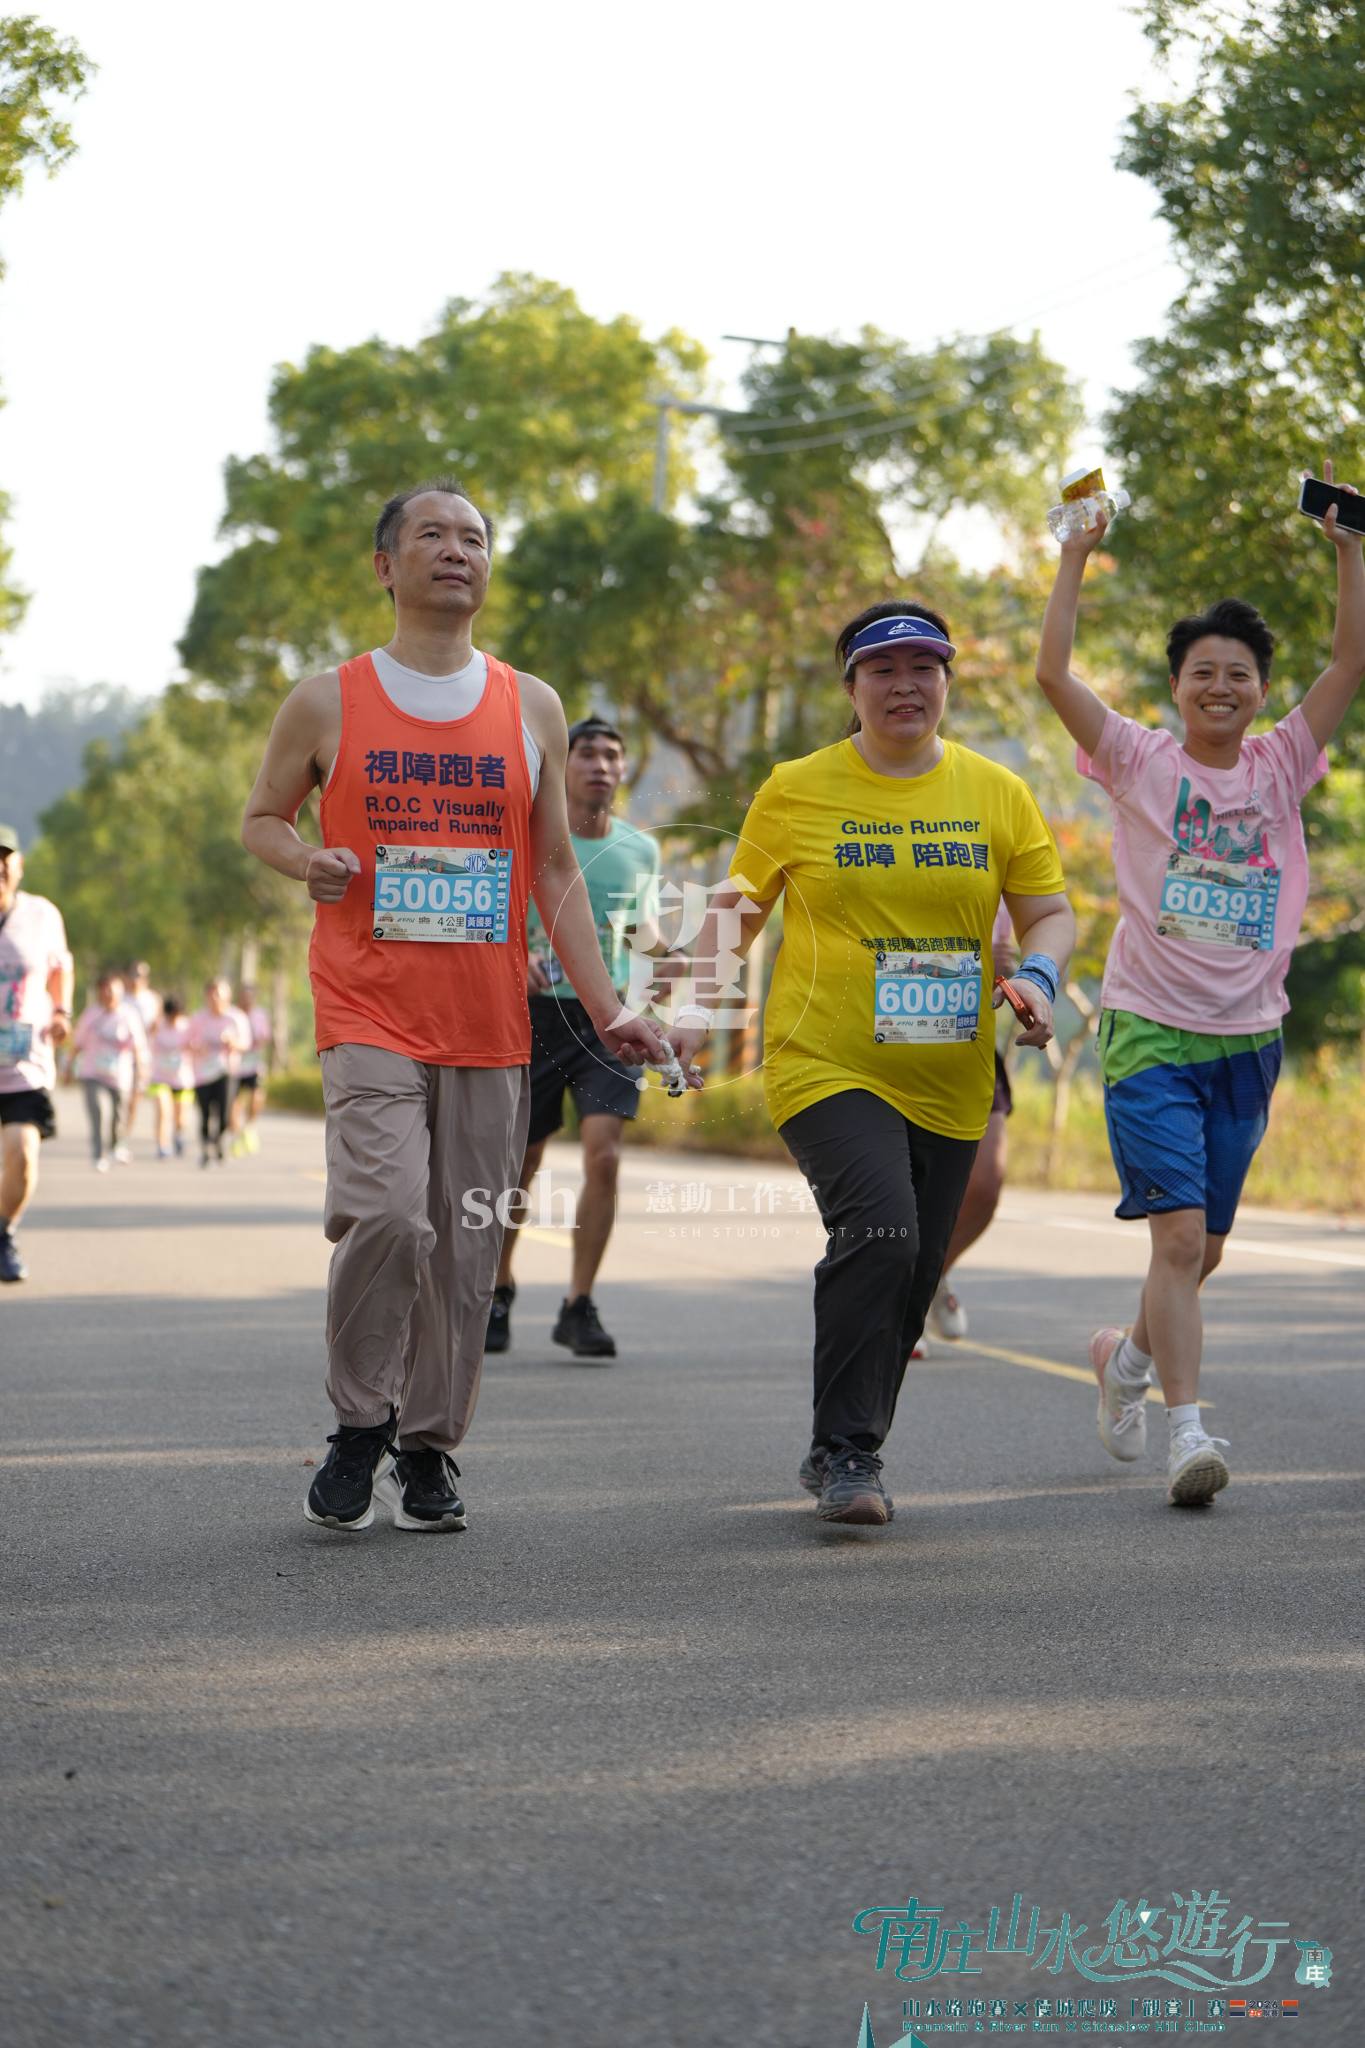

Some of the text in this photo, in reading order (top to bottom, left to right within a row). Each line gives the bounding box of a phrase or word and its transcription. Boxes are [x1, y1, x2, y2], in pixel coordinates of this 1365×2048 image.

[364, 750, 506, 790] 視障跑者
[366, 796, 505, 822] R.O.C Visually
[368, 817, 503, 835] Impaired Runner
[841, 820, 981, 835] Guide Runner
[833, 842, 989, 871] 視障 陪跑員
[378, 877, 492, 912] 50056
[1165, 882, 1262, 922] 60393
[878, 981, 977, 1014] 60096
